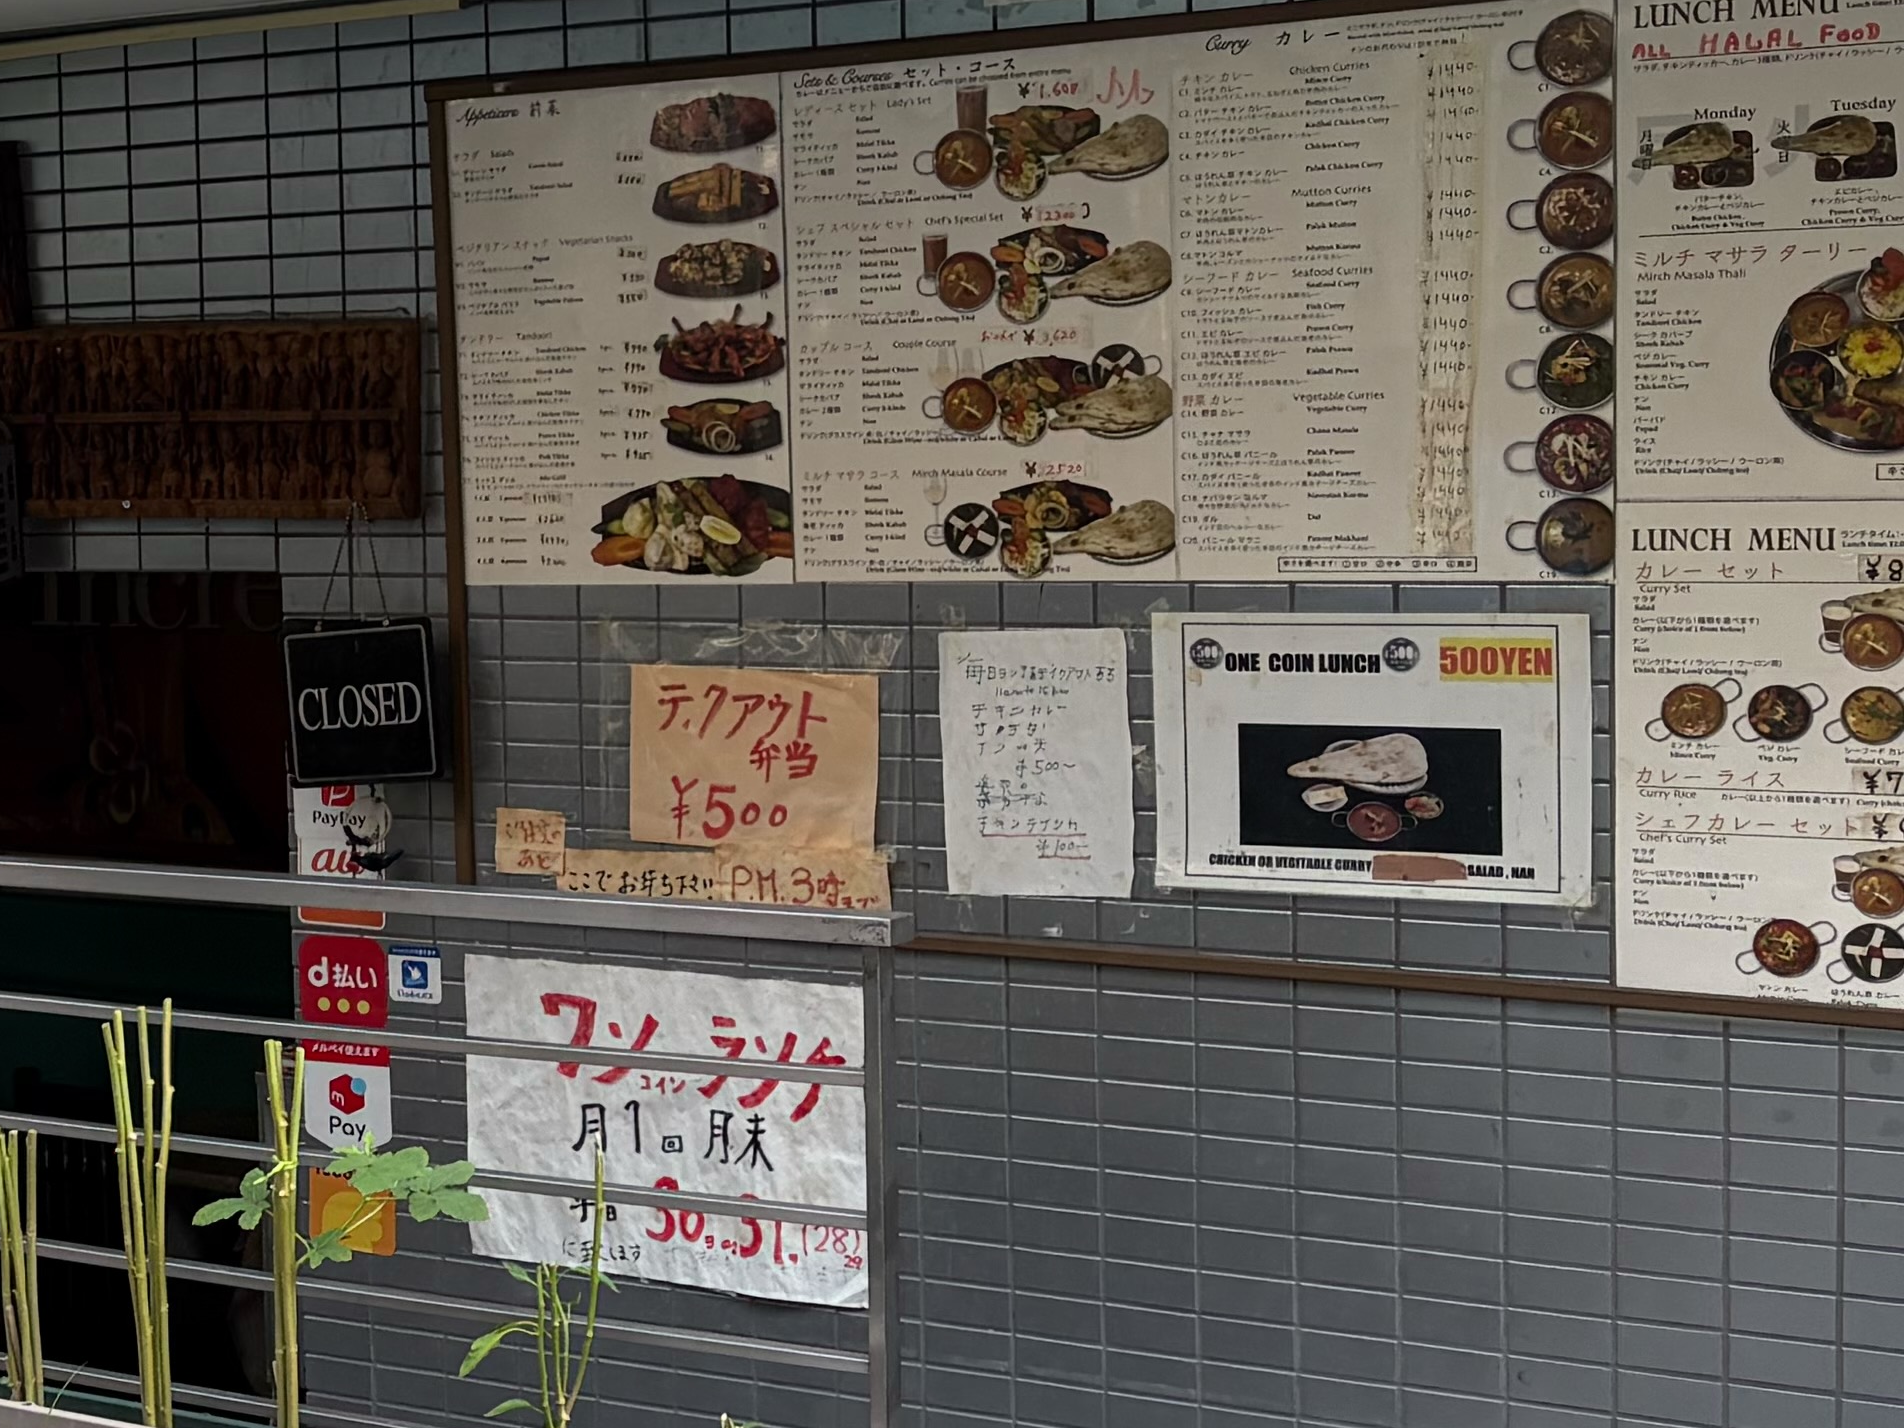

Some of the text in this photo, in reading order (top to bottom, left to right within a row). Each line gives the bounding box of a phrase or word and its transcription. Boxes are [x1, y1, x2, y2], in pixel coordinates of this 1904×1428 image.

[1205, 33, 1253, 56] Curry
[1276, 29, 1341, 47] カレー
[1632, 43, 1671, 59] ALL
[1289, 60, 1370, 75] Chicken Curries
[1694, 106, 1756, 121] Monday
[1830, 97, 1897, 113] Tuesday
[1334, 184, 1372, 195] Curries
[1634, 241, 1868, 268] ミルチ マサラ ターリー
[1292, 266, 1334, 278] Seafood
[1637, 271, 1671, 282] Mirch
[1674, 270, 1715, 281] Masala
[1632, 527, 1836, 552] LUNCH MENU
[1635, 561, 1785, 581] カレー セット
[1639, 584, 1691, 595] Curry Set
[1224, 645, 1553, 676] ONE COIN LUNCH 500YEN
[297, 681, 422, 733] CLOSED
[749, 740, 820, 782] 弁当
[1635, 766, 1785, 787] カレー ライス
[1639, 788, 1671, 800] Curry
[670, 775, 788, 840] ¥500
[1790, 817, 1859, 837] セット
[1639, 833, 1727, 846] Chef's Curry Set
[307, 955, 378, 989] d払い
[329, 1115, 367, 1143] Pay
